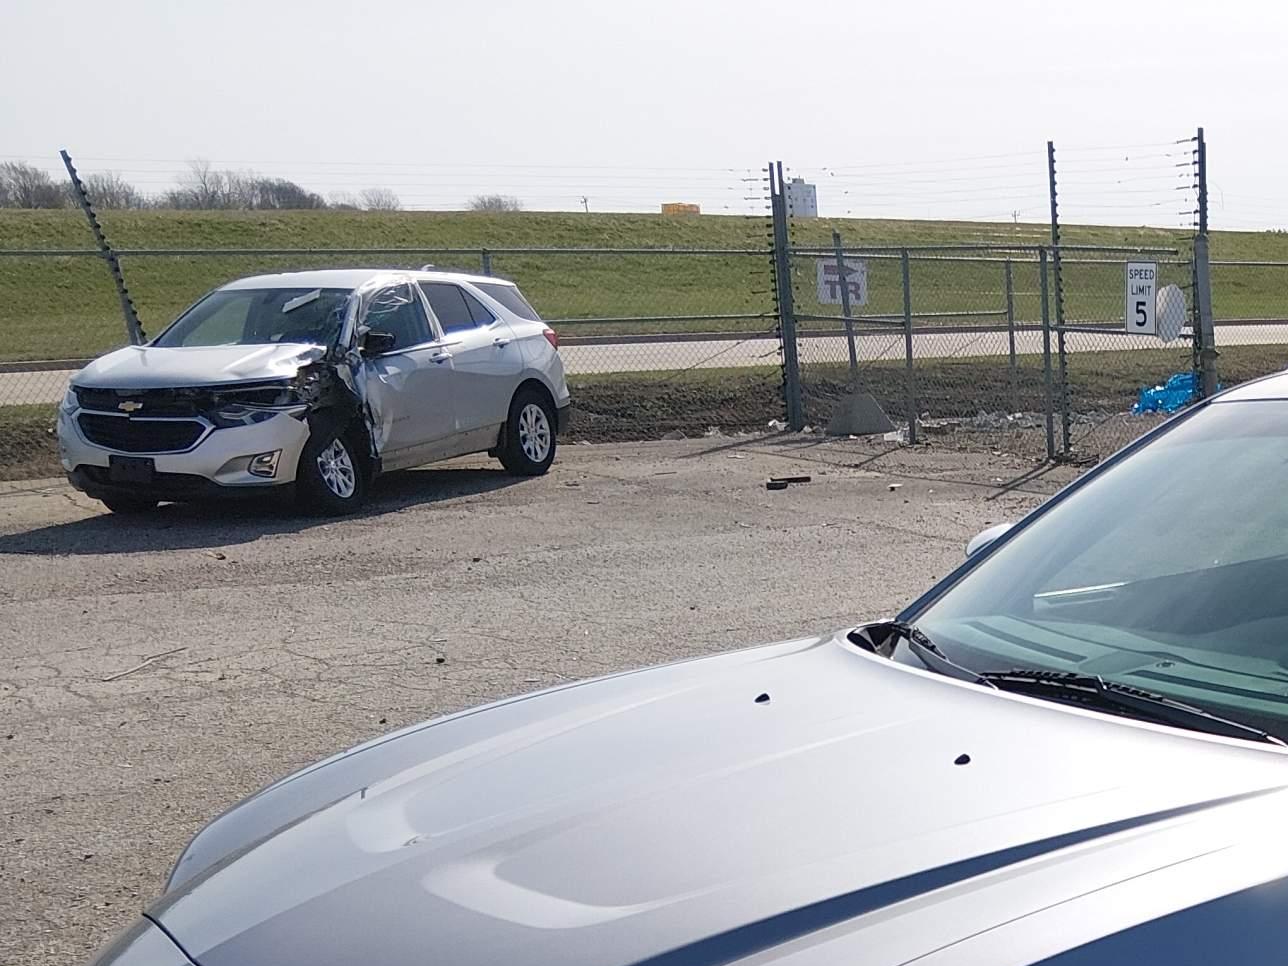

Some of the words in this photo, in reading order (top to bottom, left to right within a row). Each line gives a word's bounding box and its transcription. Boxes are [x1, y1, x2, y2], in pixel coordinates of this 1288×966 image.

[1129, 269, 1155, 280] SPEED
[1131, 285, 1152, 296] LIMIT
[1135, 301, 1148, 327] 5
